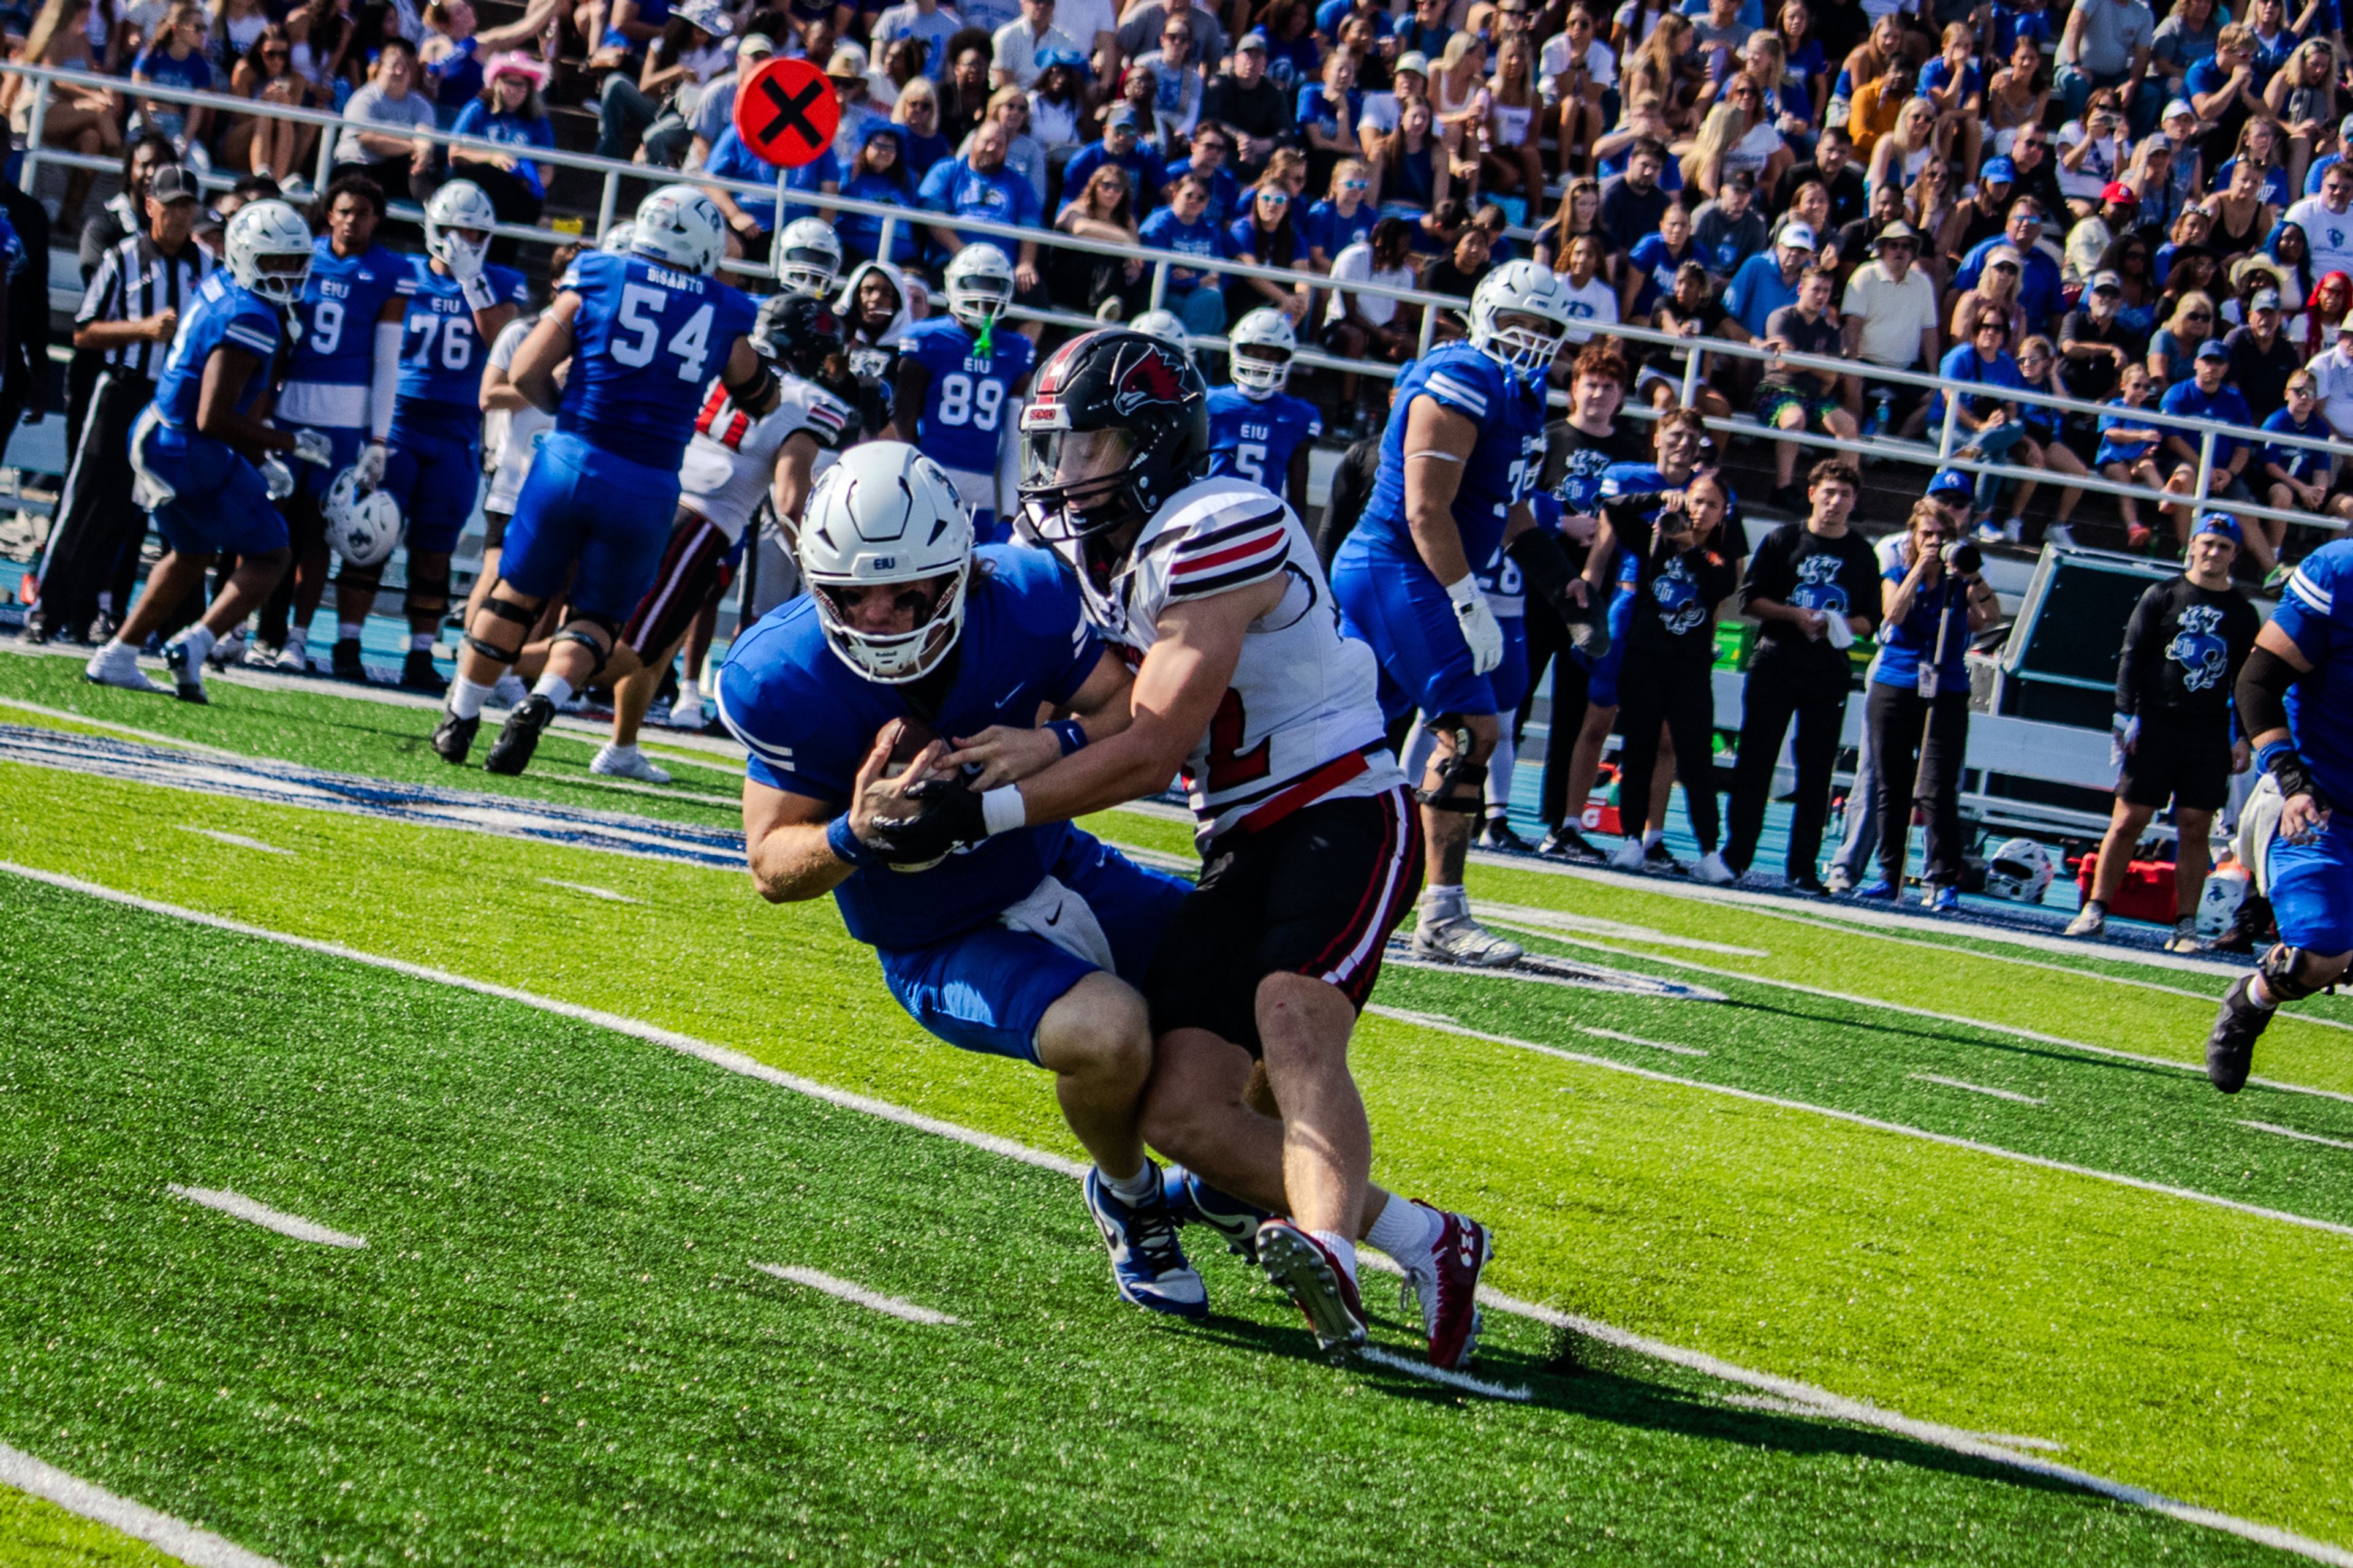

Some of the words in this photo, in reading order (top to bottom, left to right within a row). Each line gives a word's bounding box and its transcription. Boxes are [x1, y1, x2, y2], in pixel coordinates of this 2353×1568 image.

[320, 279, 349, 298] EIU
[431, 297, 460, 313] EIU
[311, 300, 344, 355] 9
[410, 314, 473, 369] 76
[610, 281, 715, 384] 54
[963, 357, 991, 374] EIU
[938, 374, 1003, 431] 89
[1241, 423, 1268, 441] EIU
[1235, 443, 1266, 486] 5
[874, 557, 895, 570] EIU
